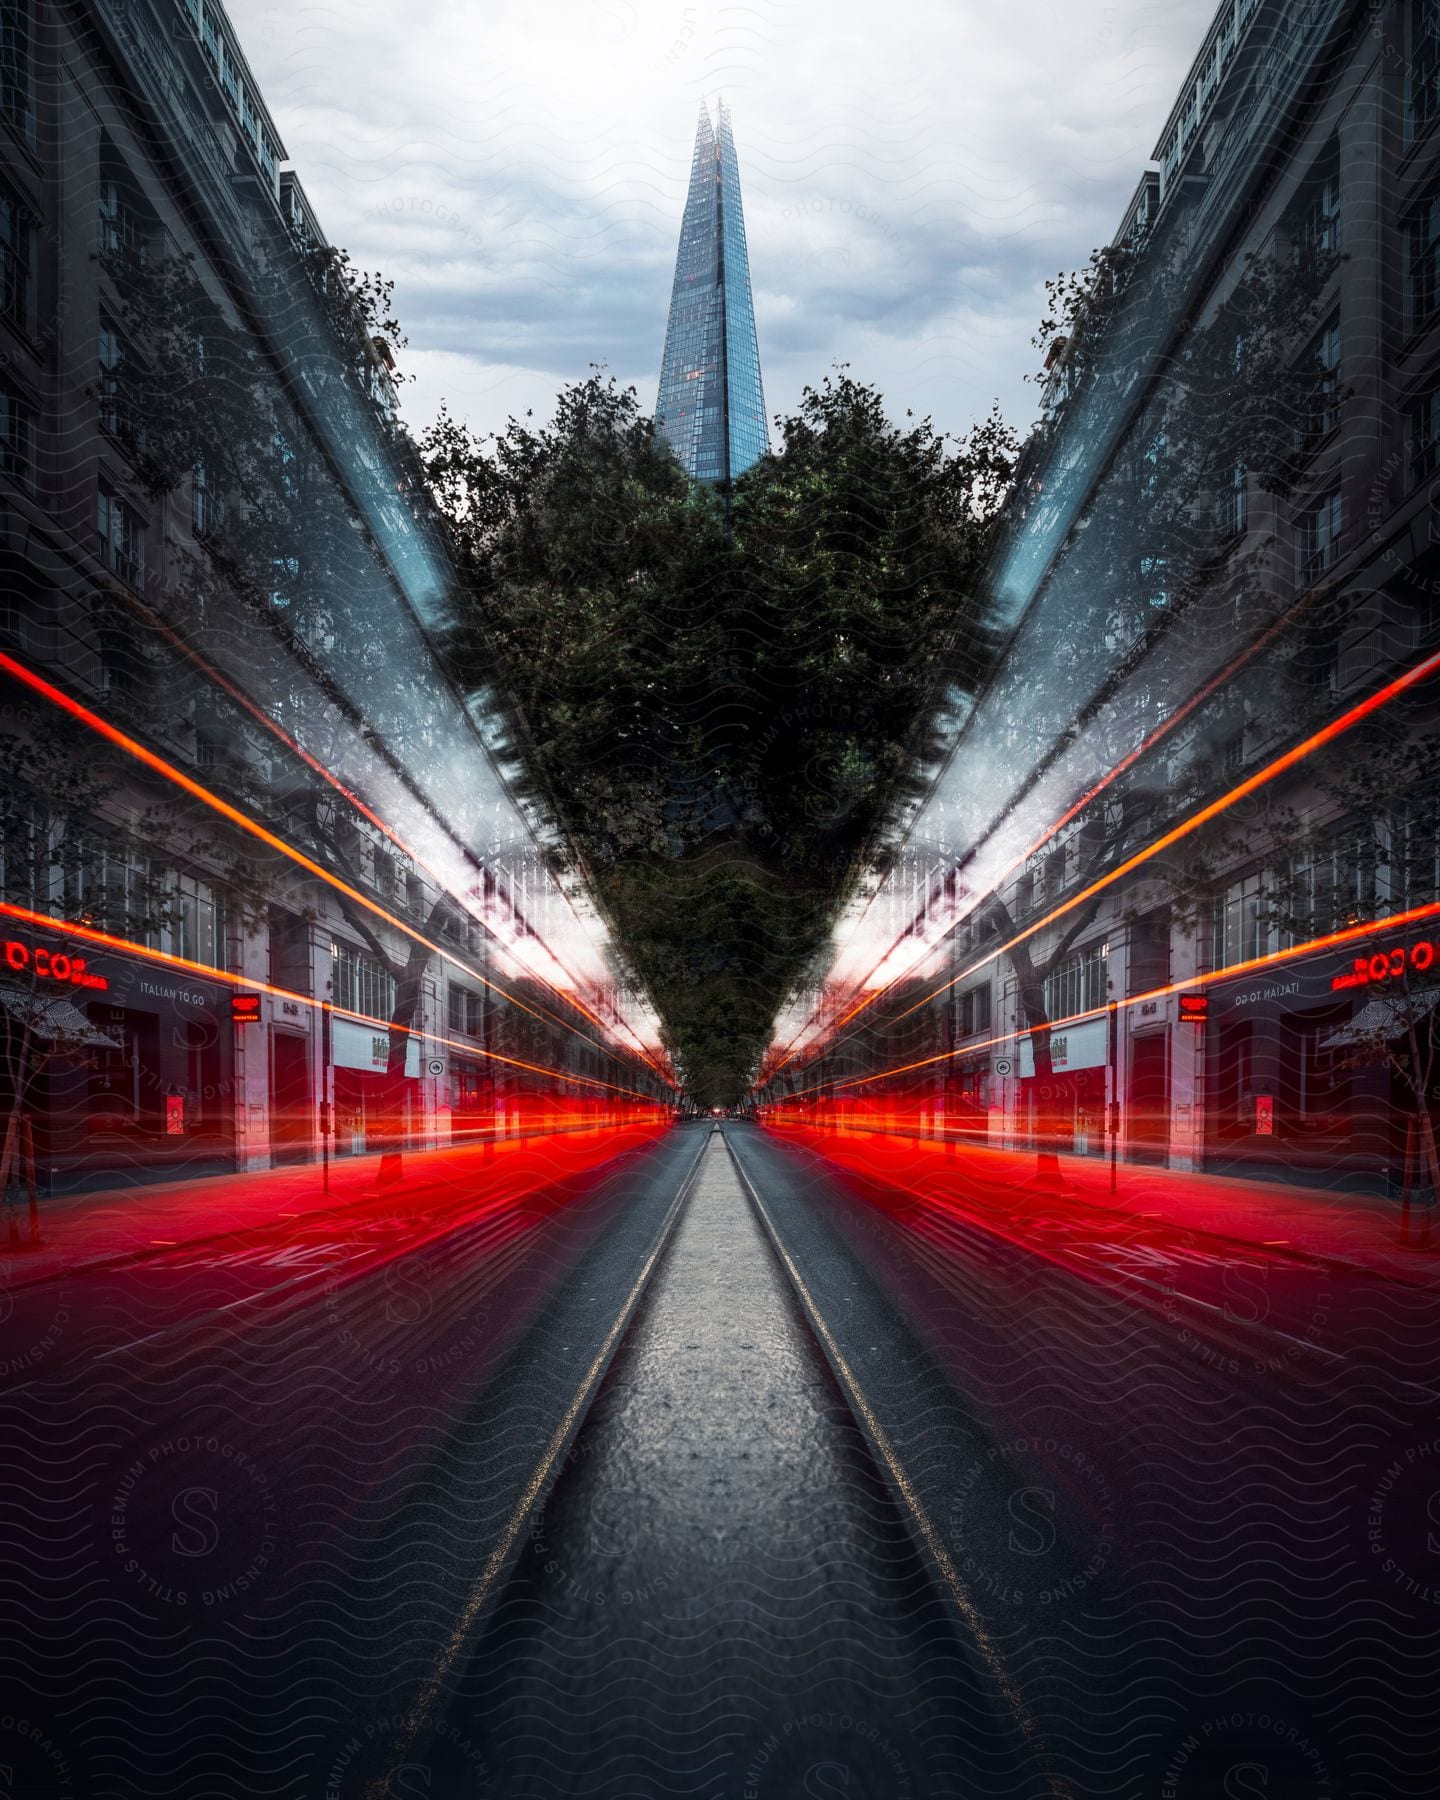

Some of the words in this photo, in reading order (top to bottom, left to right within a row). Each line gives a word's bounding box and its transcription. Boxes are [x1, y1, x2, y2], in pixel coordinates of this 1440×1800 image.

[140, 981, 176, 1000] ITALIAN
[178, 991, 190, 1002] TO
[192, 994, 205, 1006] GO
